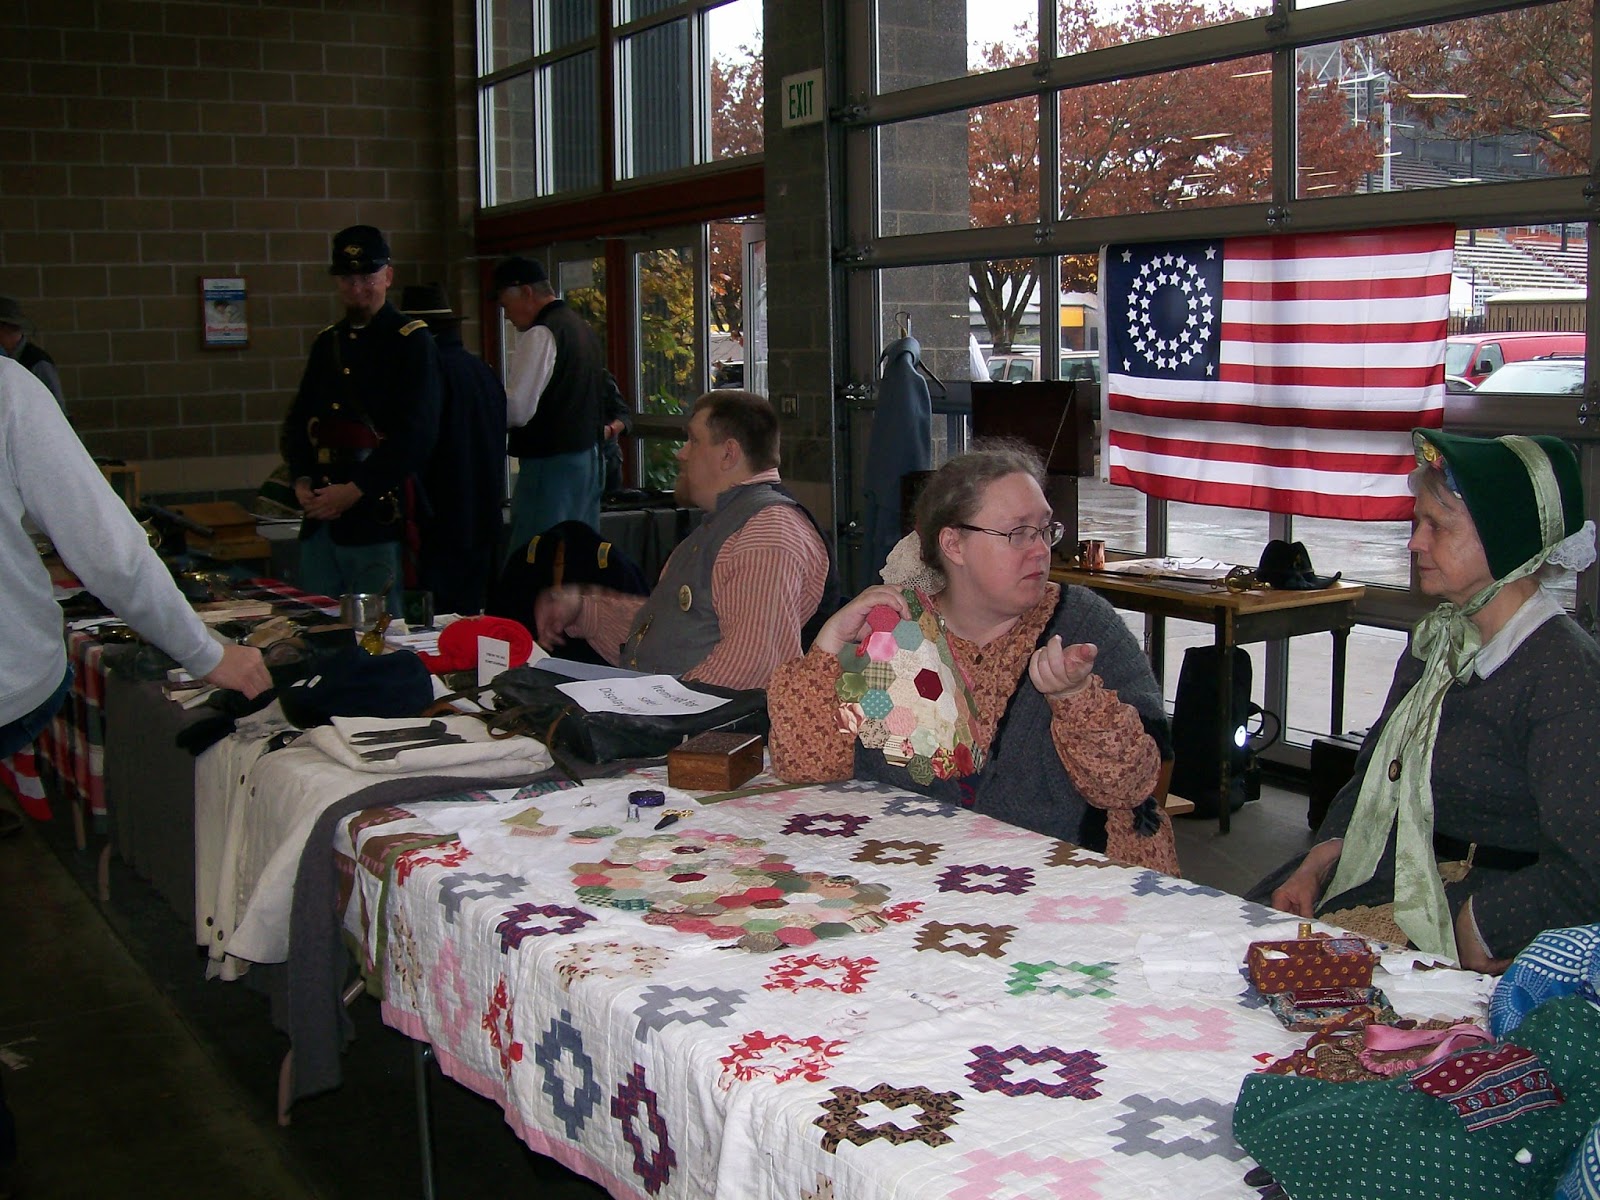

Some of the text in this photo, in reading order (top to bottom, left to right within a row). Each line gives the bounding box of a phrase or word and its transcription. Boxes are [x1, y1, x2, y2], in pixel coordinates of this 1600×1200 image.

[789, 80, 814, 119] EXIT
[598, 687, 625, 707] Display
[651, 684, 672, 699] Items
